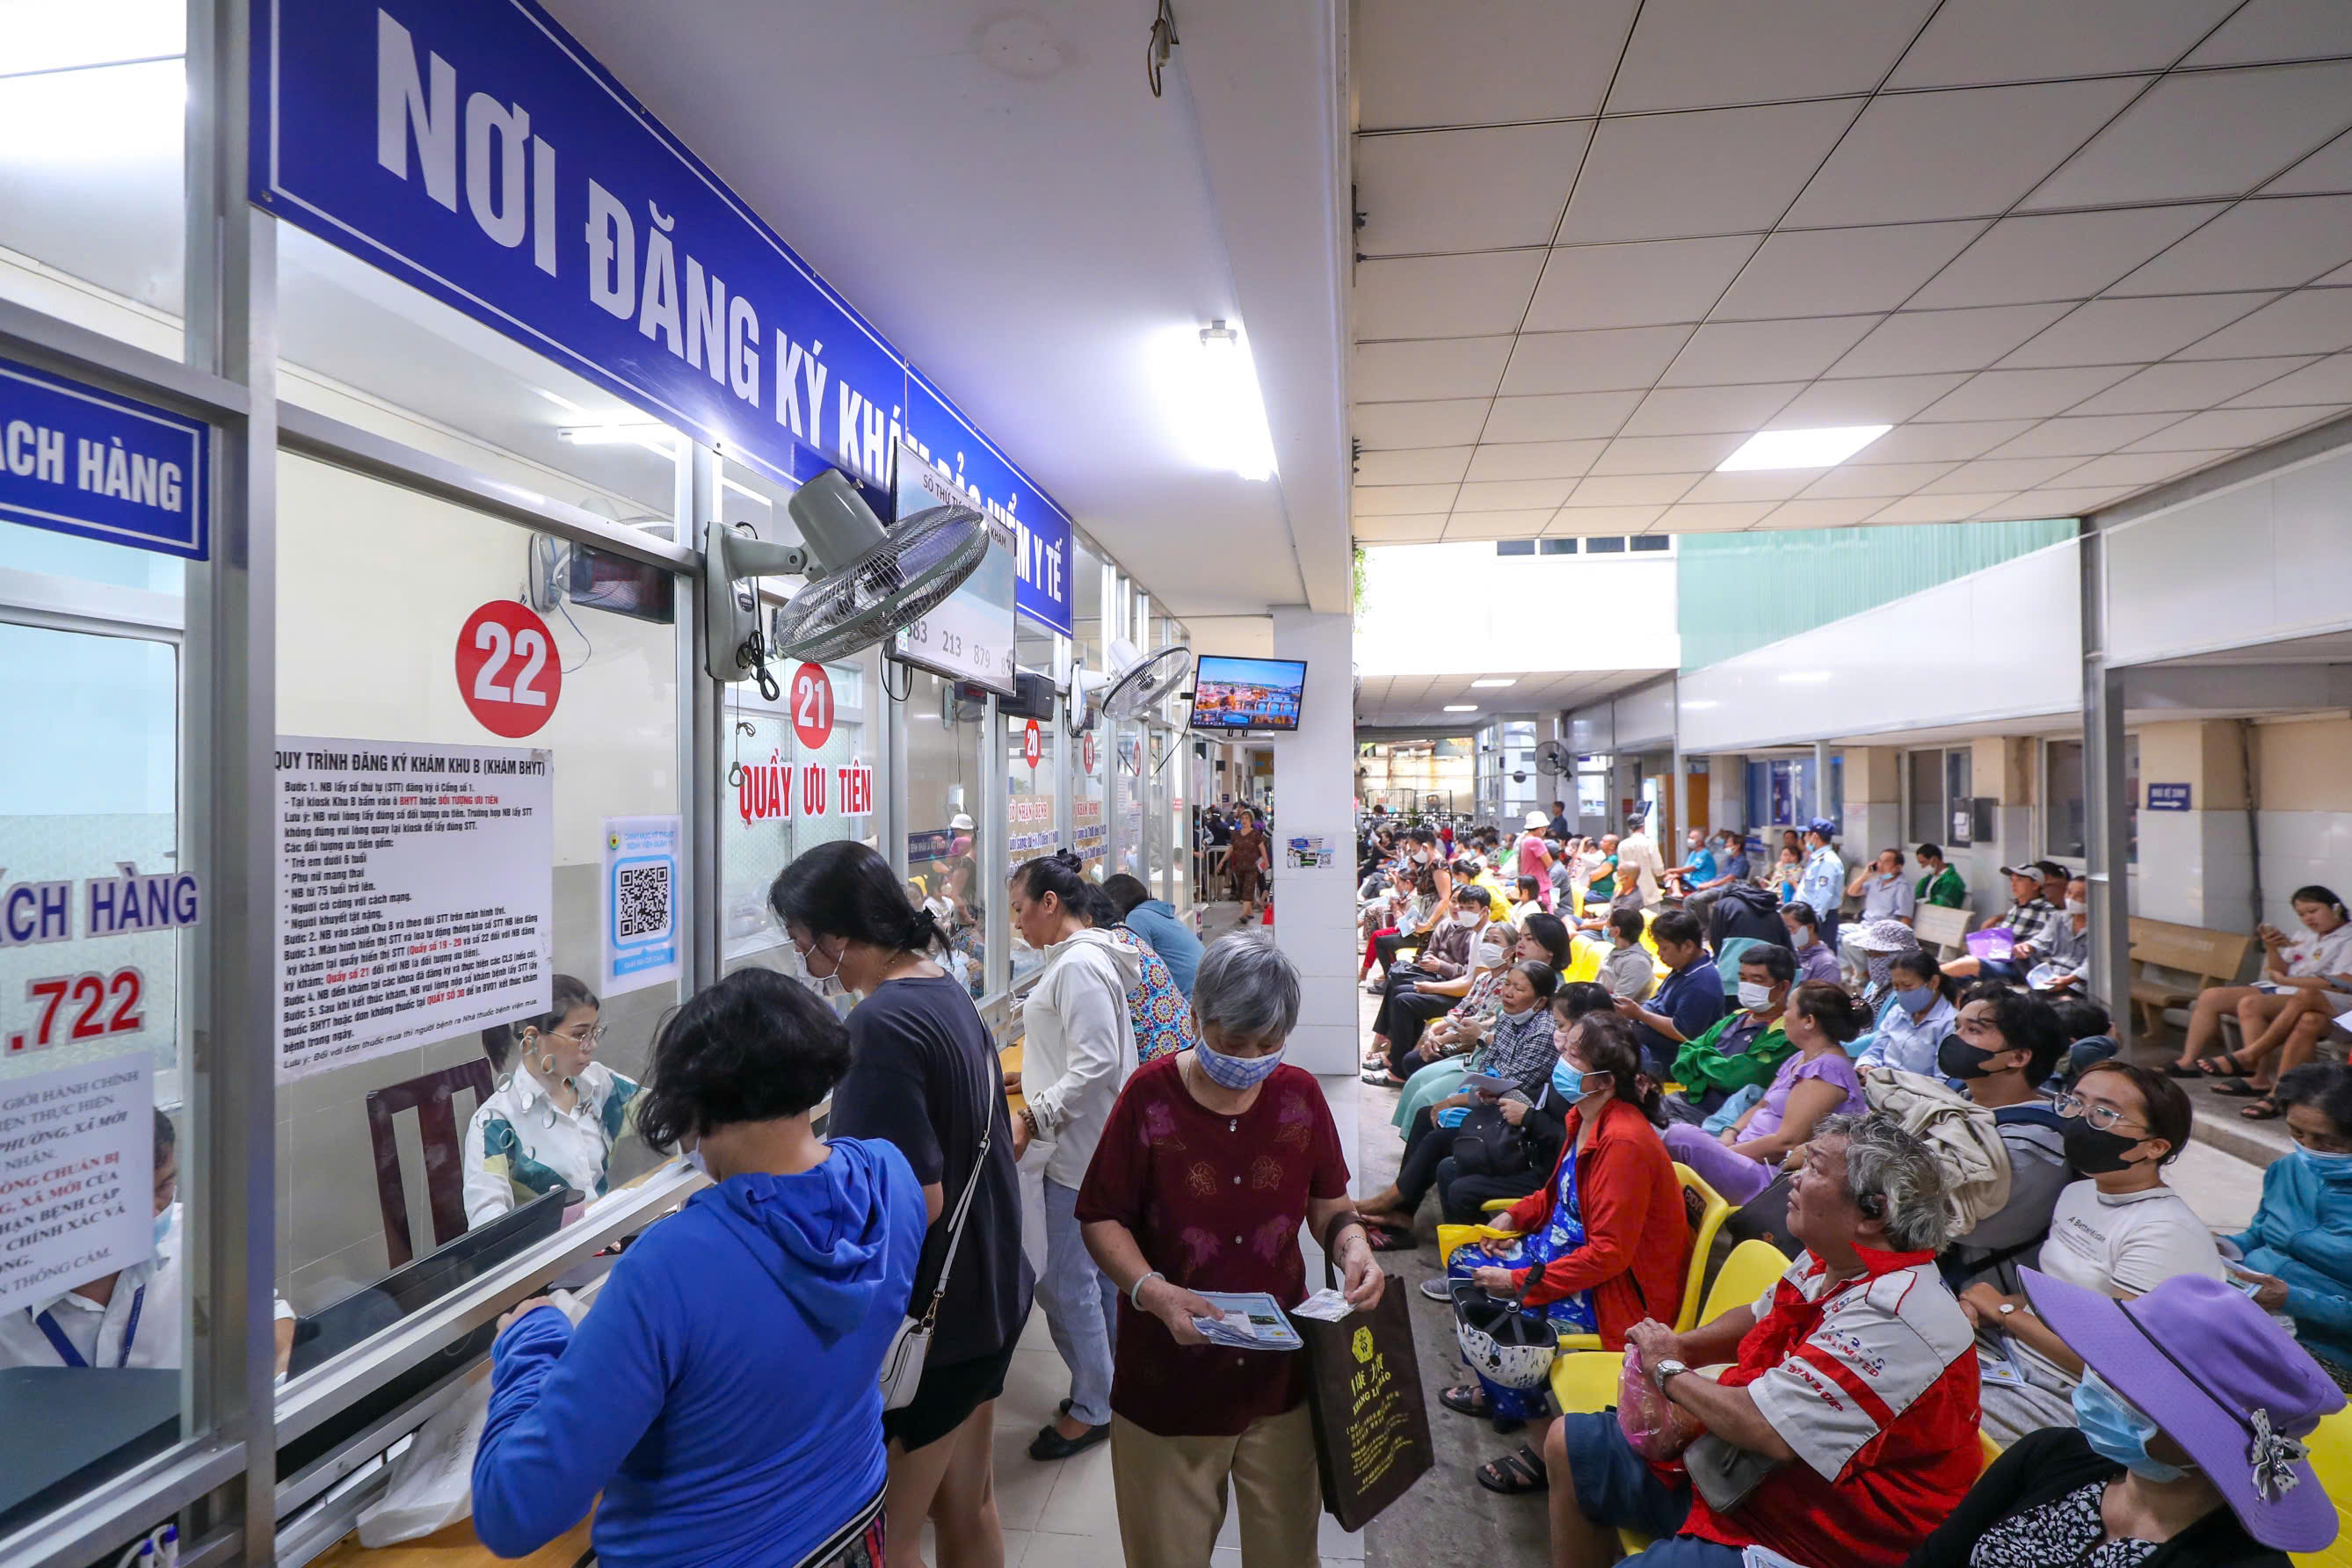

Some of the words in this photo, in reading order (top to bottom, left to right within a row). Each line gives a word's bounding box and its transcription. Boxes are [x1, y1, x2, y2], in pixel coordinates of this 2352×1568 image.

[378, 8, 555, 278] NƠI
[585, 178, 759, 408] ĐĂNG
[776, 328, 827, 449] KÝ
[1034, 534, 1042, 590] Y
[1046, 538, 1063, 603] TẾ
[0, 420, 64, 484] CH
[78, 436, 181, 512] HÀNG
[924, 474, 933, 492] SỐ
[935, 483, 950, 505] THỨ
[942, 630, 961, 657] 213
[974, 644, 990, 668] 879
[474, 621, 546, 706] 22
[798, 676, 825, 729] 21
[1027, 729, 1037, 757] 20
[1085, 742, 1092, 765] 19
[275, 751, 301, 771] QUY
[307, 750, 347, 771] TRÌNH
[352, 751, 388, 771] ĐĂNG
[392, 752, 407, 772] KÝ
[411, 754, 445, 773] KHÁM
[448, 758, 469, 773] KHU
[474, 759, 479, 773] B
[484, 758, 515, 775] (KHÁM
[519, 761, 545, 776] BHYT)
[310, 782, 317, 791] 1.
[320, 782, 331, 791] NB
[385, 783, 403, 792] (STT)
[740, 749, 791, 825] QUẦY
[803, 763, 825, 815] ƯU
[838, 759, 870, 813] TIÊN
[352, 797, 355, 806] B
[400, 796, 417, 805] BHYT
[313, 812, 324, 821] NB
[309, 858, 321, 867] em
[345, 855, 349, 864] 6
[0, 886, 66, 942] CH
[91, 867, 197, 933] HÀNG
[292, 888, 303, 898] NB
[318, 886, 327, 896] 75
[320, 930, 330, 940] NB
[437, 914, 448, 923] STT
[389, 934, 401, 944] STT
[493, 919, 503, 928] STT
[392, 947, 404, 957] STT
[454, 938, 461, 947] 20
[482, 933, 489, 942] 22
[360, 969, 368, 977] 21
[400, 960, 409, 969] NB
[410, 985, 420, 994] NB
[518, 962, 527, 971] STT
[317, 990, 329, 1000] NB
[11, 971, 141, 1051] .722
[310, 1018, 331, 1031] BHYT
[6, 1224, 62, 1251] CHÍNH
